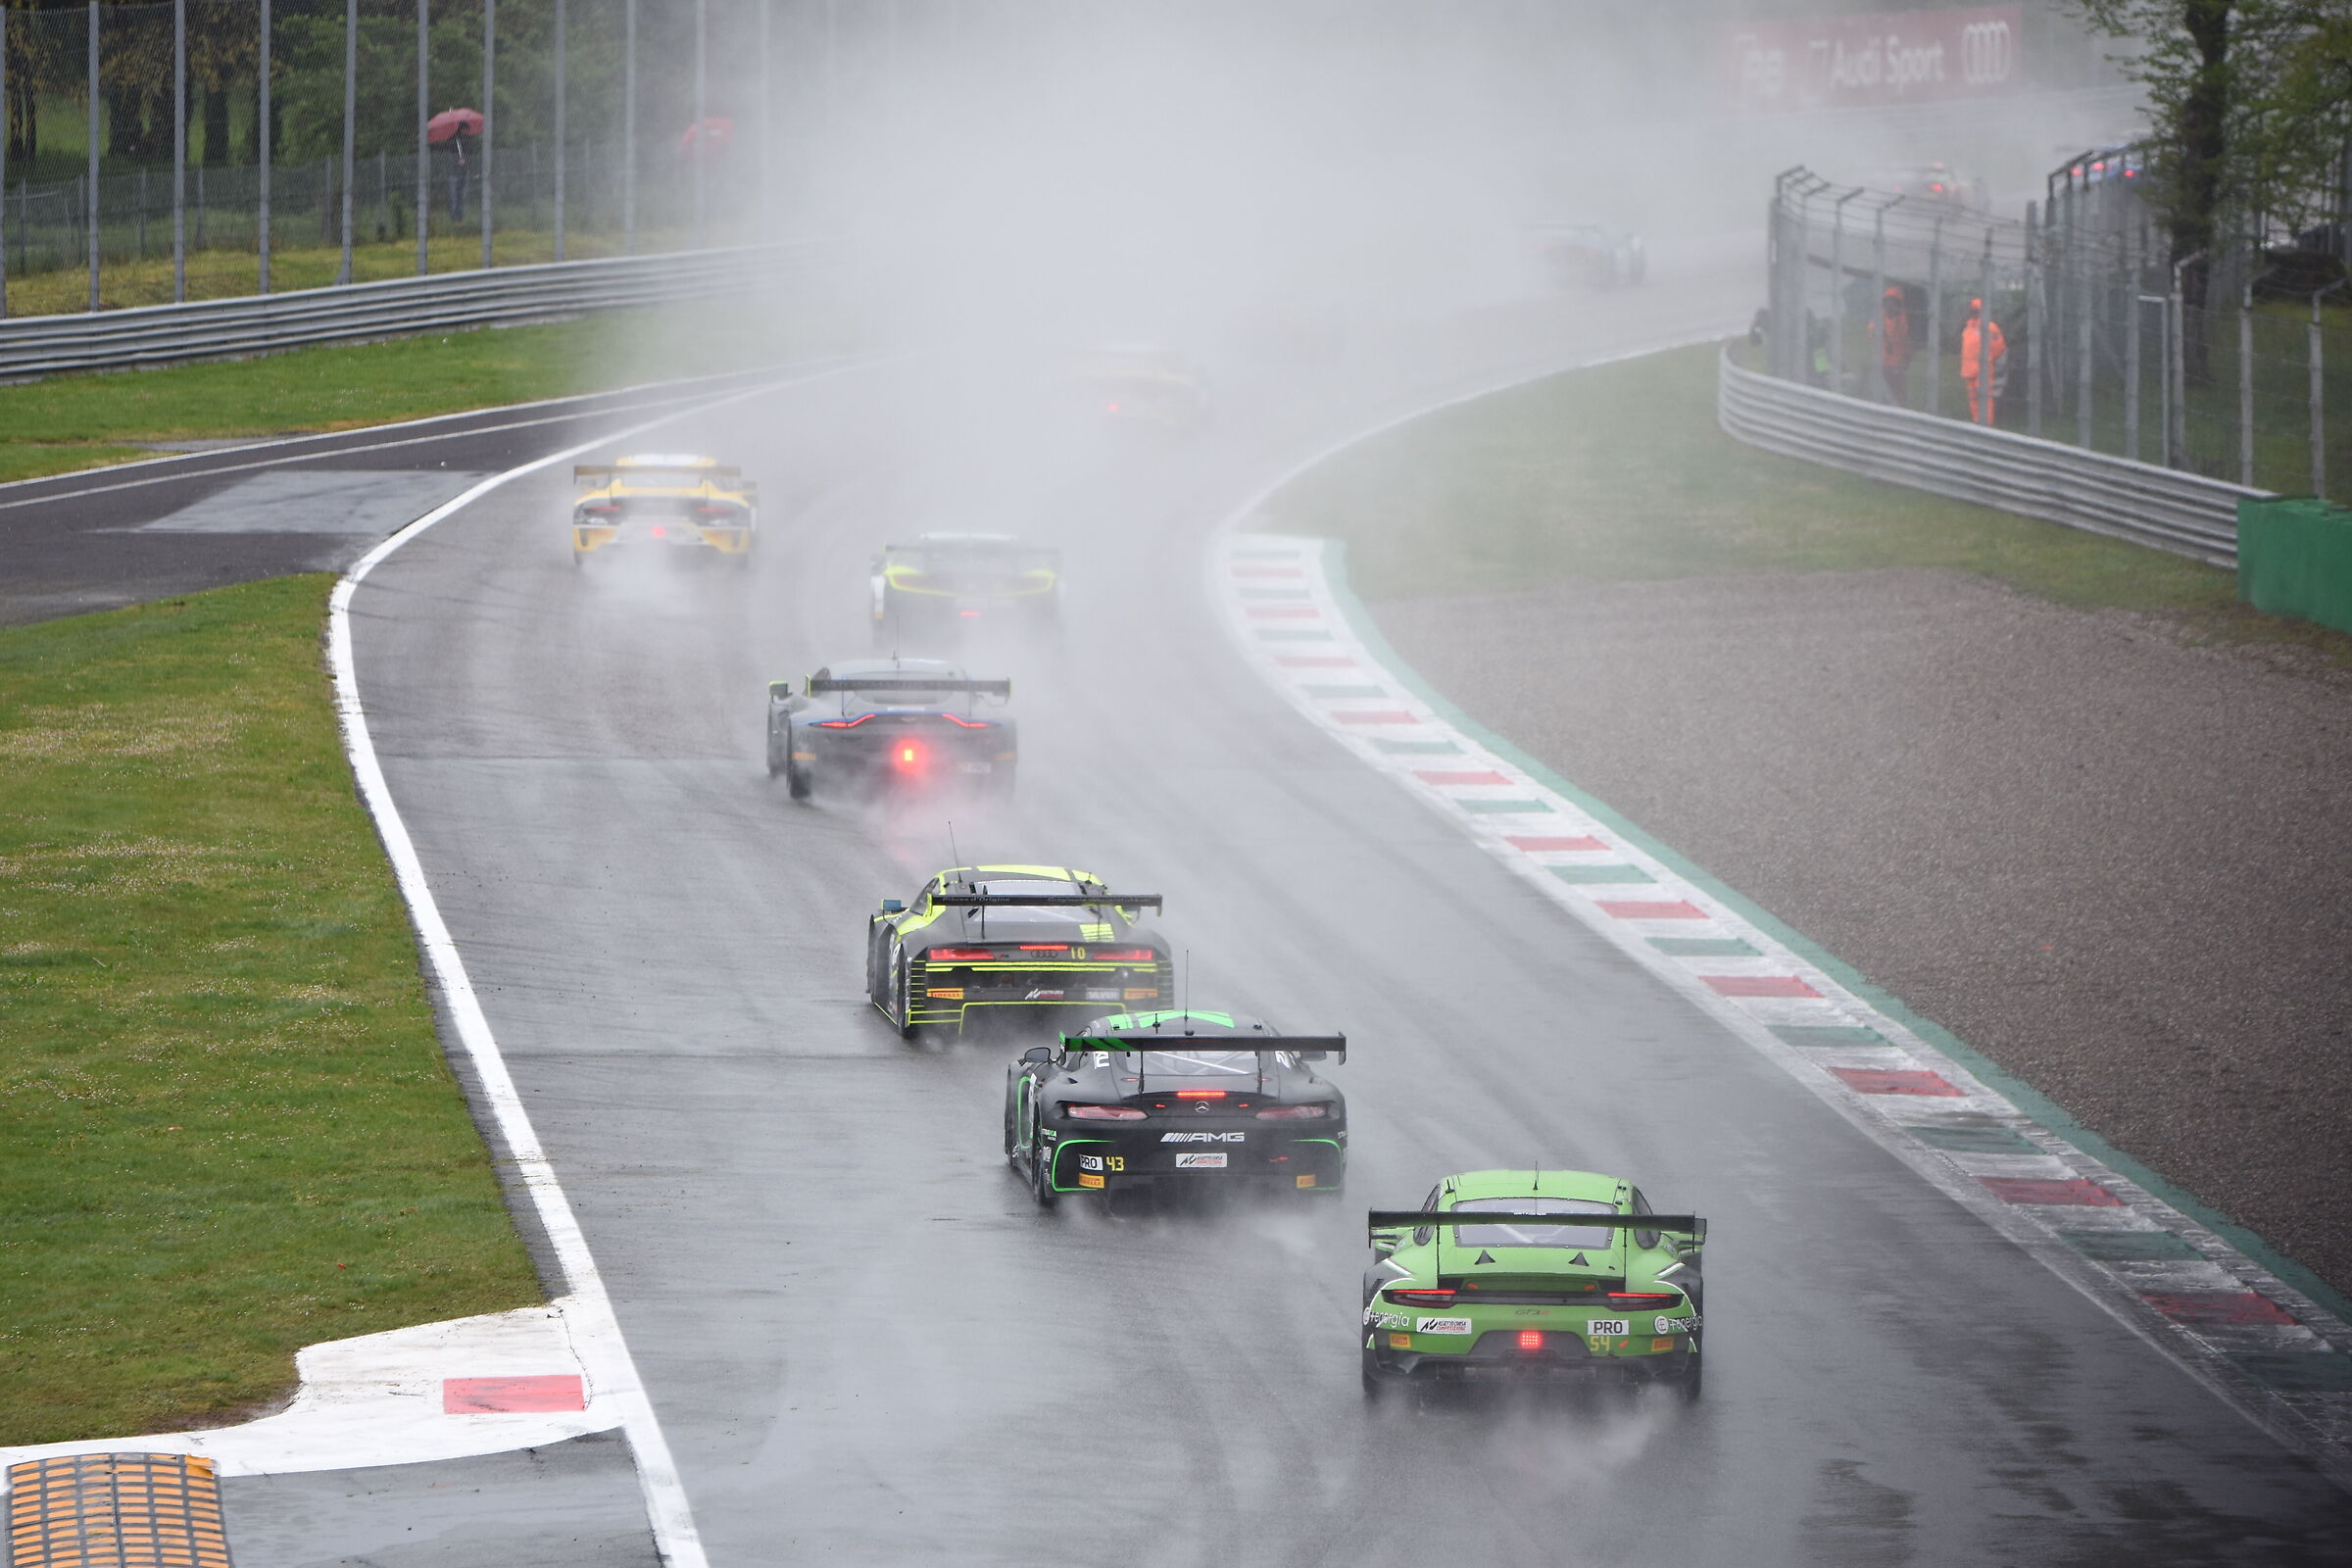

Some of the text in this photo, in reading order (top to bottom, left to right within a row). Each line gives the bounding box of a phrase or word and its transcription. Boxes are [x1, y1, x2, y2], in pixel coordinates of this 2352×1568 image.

[1830, 37, 1881, 88] Audi
[1885, 34, 1945, 97] Sport
[1071, 947, 1086, 959] 10
[1187, 1132, 1245, 1143] AMG
[1081, 1155, 1099, 1169] PRO
[1106, 1156, 1124, 1171] 43
[1593, 1321, 1623, 1334] PRO
[1590, 1336, 1610, 1352] 54
